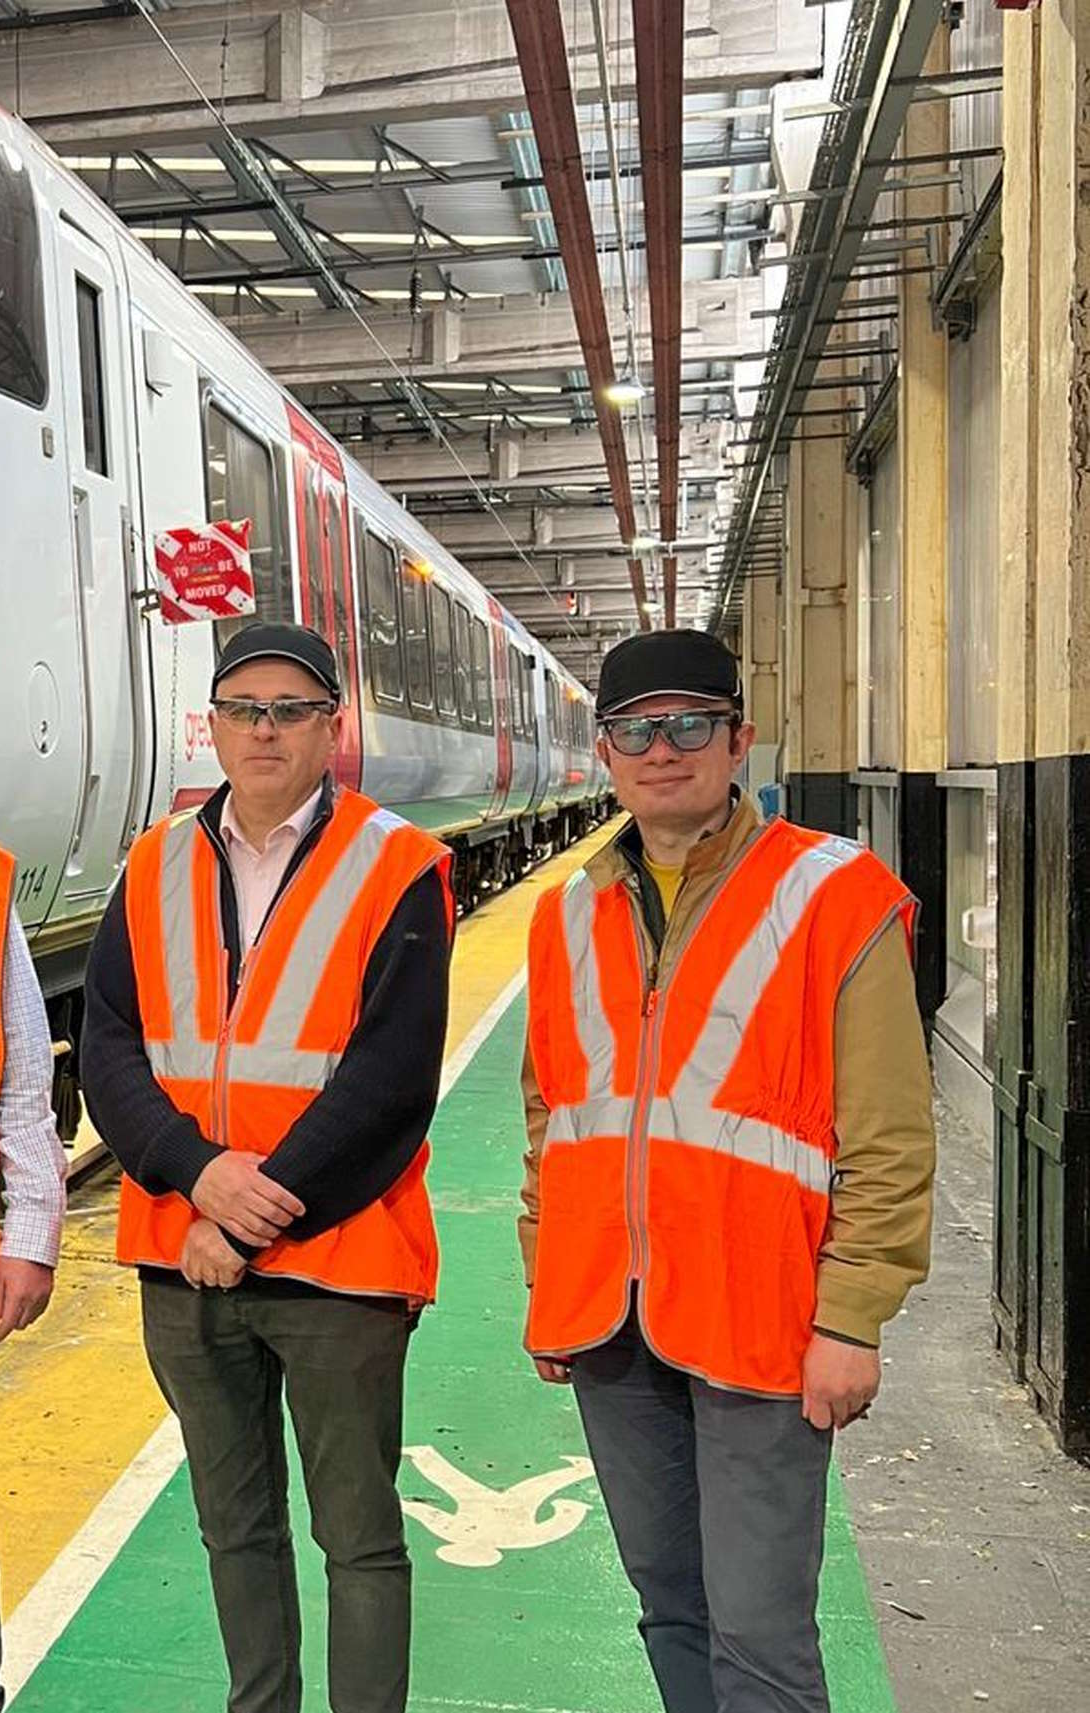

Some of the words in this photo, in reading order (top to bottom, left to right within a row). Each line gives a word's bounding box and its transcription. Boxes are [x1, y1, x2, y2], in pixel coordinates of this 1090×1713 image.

[188, 541, 212, 553] NOT
[174, 566, 189, 578] TO
[217, 560, 234, 572] BE
[185, 584, 227, 600] MOVED
[15, 864, 49, 904] 114
